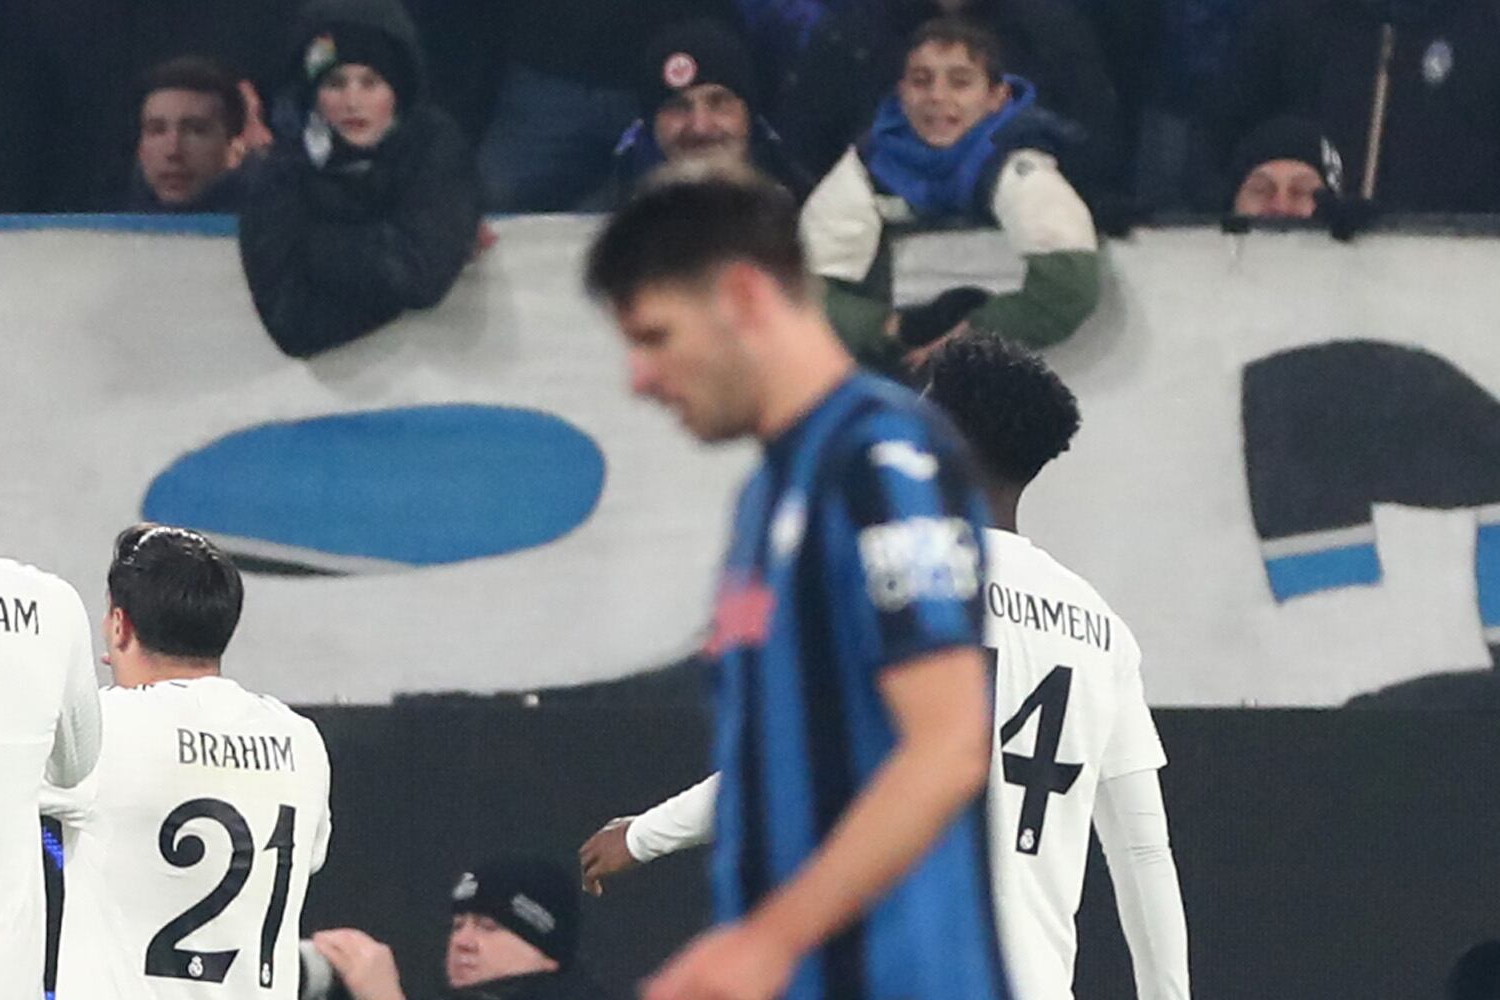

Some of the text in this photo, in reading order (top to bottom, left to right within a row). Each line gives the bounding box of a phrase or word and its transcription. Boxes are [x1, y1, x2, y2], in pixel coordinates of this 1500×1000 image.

[989, 581, 1111, 651] OUAMENI
[177, 728, 296, 772] BRAHIM
[986, 646, 1084, 856] 4
[144, 797, 296, 988] 21
